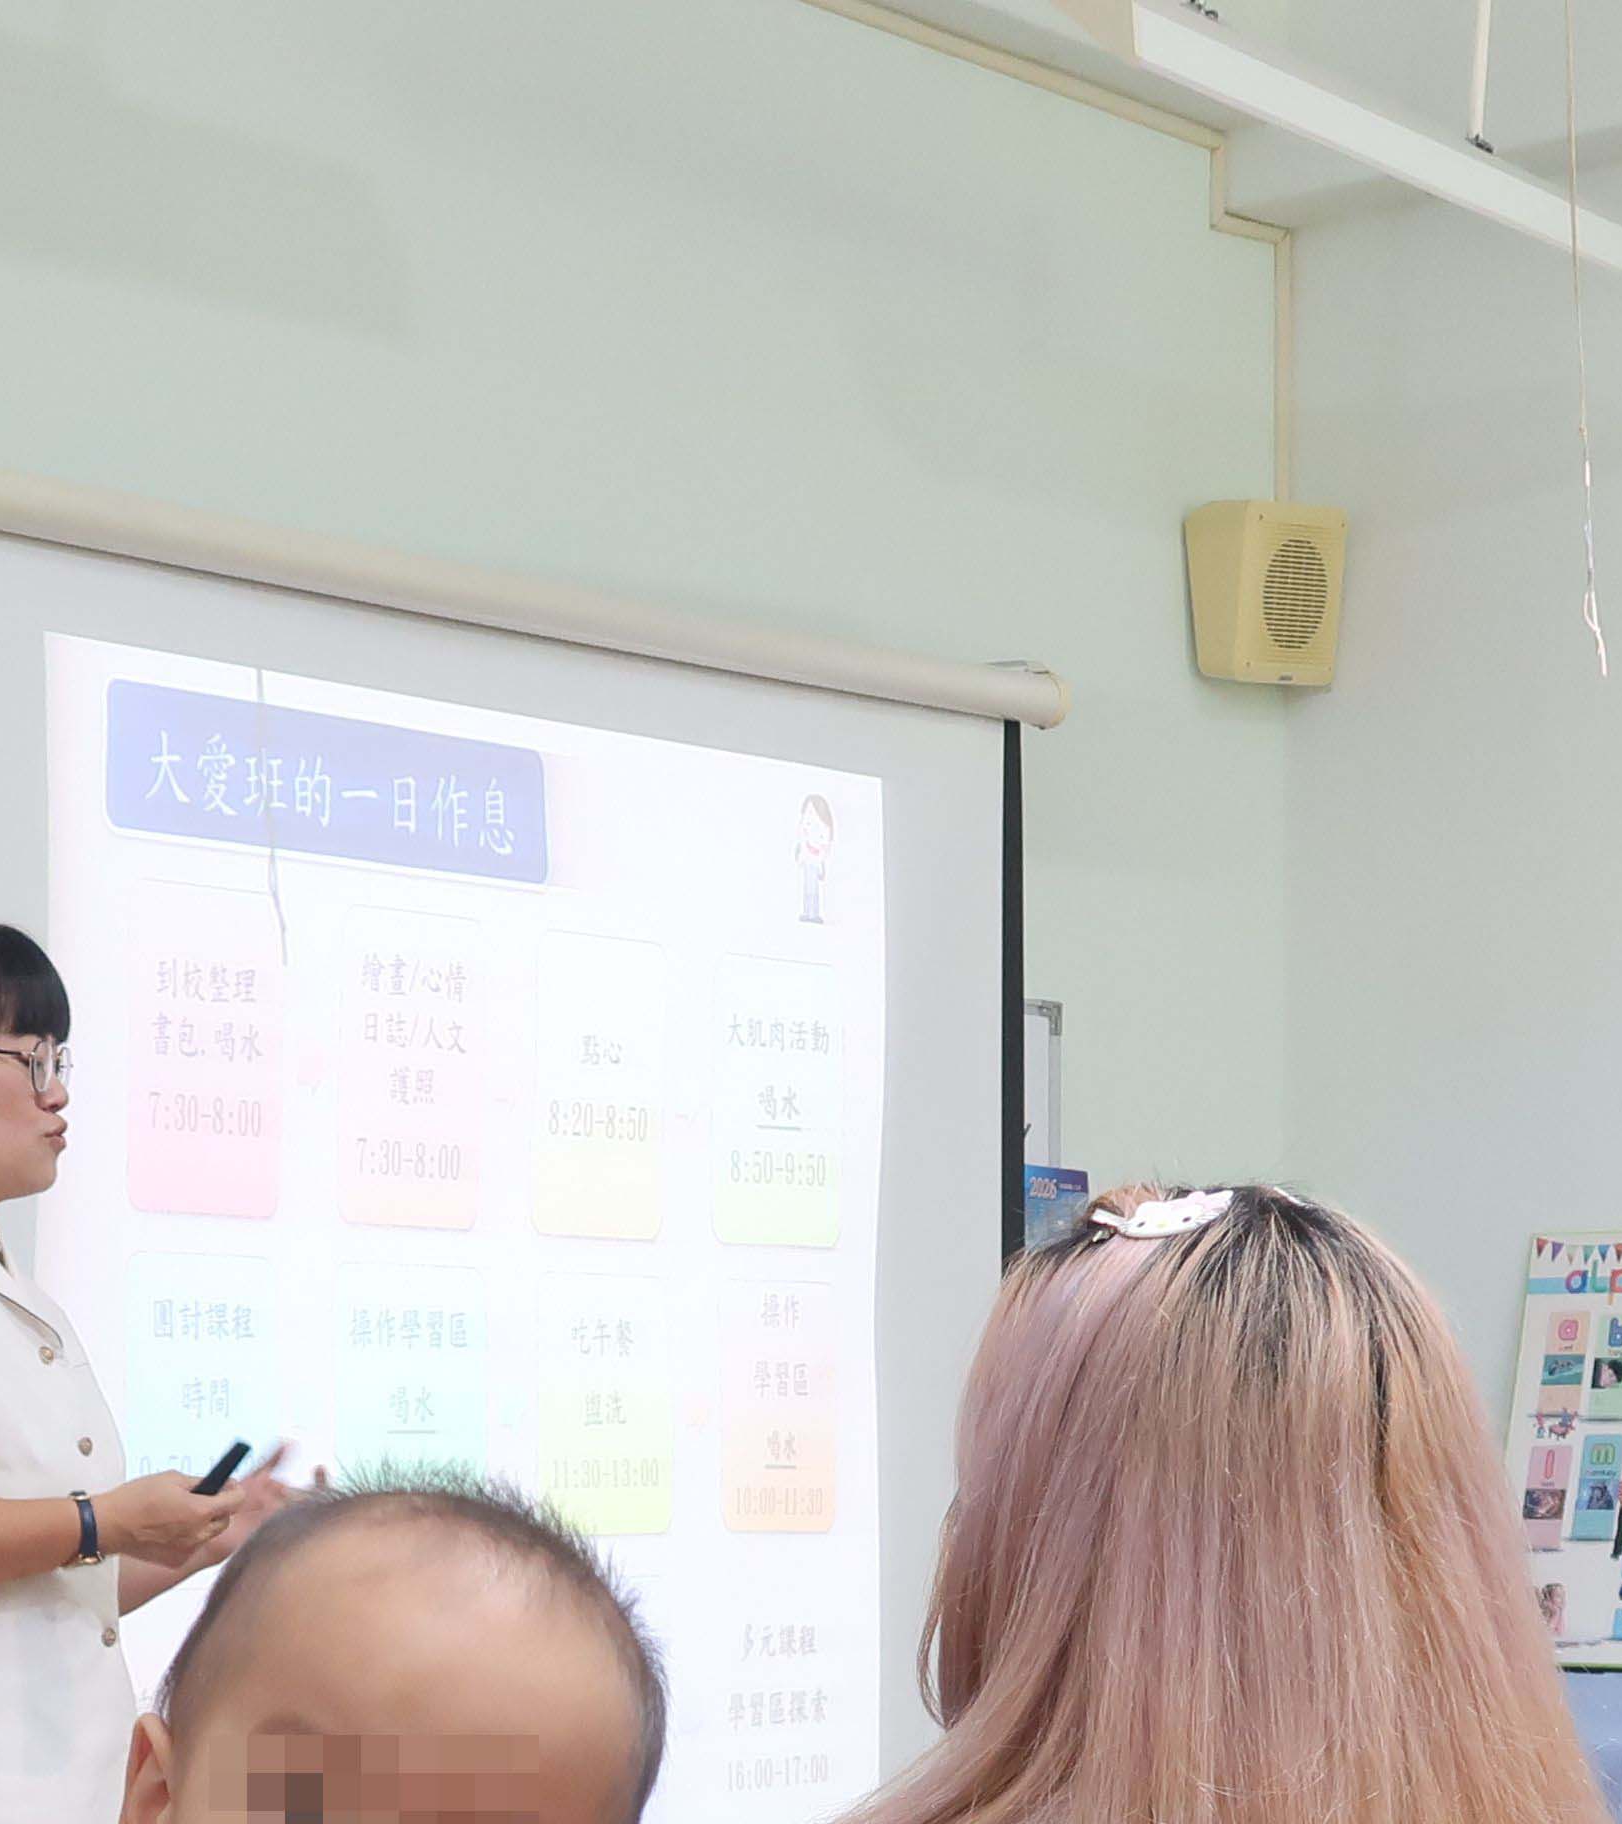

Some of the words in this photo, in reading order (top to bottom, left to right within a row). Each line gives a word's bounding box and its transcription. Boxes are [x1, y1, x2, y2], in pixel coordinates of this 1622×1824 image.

[145, 729, 514, 855] 大愛班的一日作息
[156, 958, 257, 1003] 到校整理
[362, 1012, 467, 1054] 日誌/人文
[581, 1035, 622, 1065] 點心
[726, 1014, 829, 1055] 大肌肉活動
[388, 1067, 435, 1105] 護照
[758, 1086, 801, 1120] 喝水
[148, 1091, 262, 1137] 7:30-8:00
[548, 1099, 647, 1142] 8:20-8:50
[355, 1138, 461, 1180] 7:30-8:00
[730, 1150, 826, 1186] 8:50-9:50
[350, 1307, 467, 1350] 操作學習區
[571, 1318, 636, 1356] 吃午餐
[1558, 1319, 1579, 1341] a
[388, 1385, 435, 1423] 喝水
[1590, 1443, 1615, 1465] m
